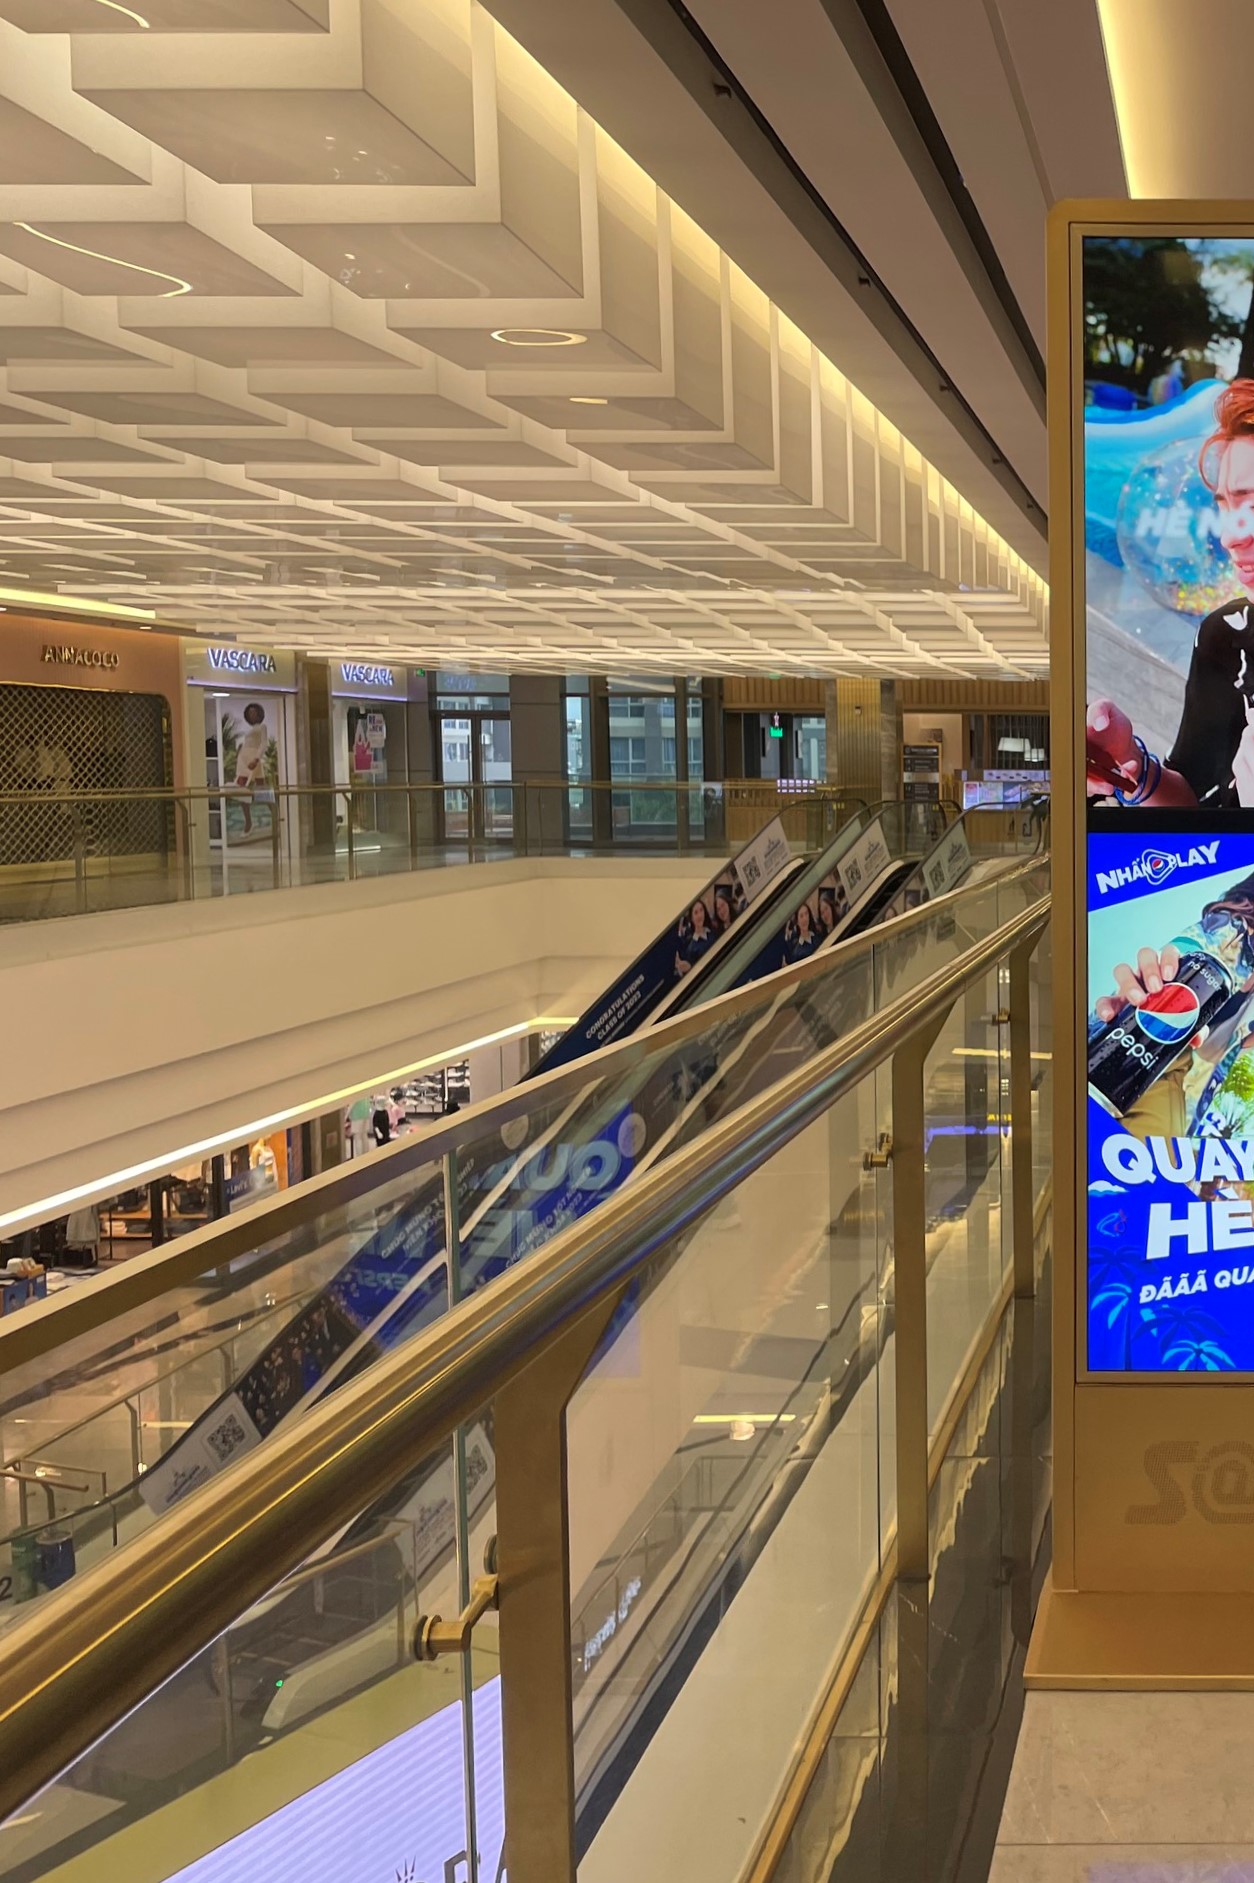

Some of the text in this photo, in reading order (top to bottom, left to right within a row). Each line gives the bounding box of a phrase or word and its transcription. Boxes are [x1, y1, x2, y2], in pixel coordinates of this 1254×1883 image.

[44, 647, 120, 668] ANNACOCO
[208, 647, 277, 673] VASCARA
[340, 663, 394, 687] VASCARA
[1187, 960, 1201, 971] no
[585, 973, 645, 1040] CONGRATULATIONS
[1105, 1026, 1160, 1070] pepsi
[1139, 1269, 1208, 1304] ĐÃÃÃ
